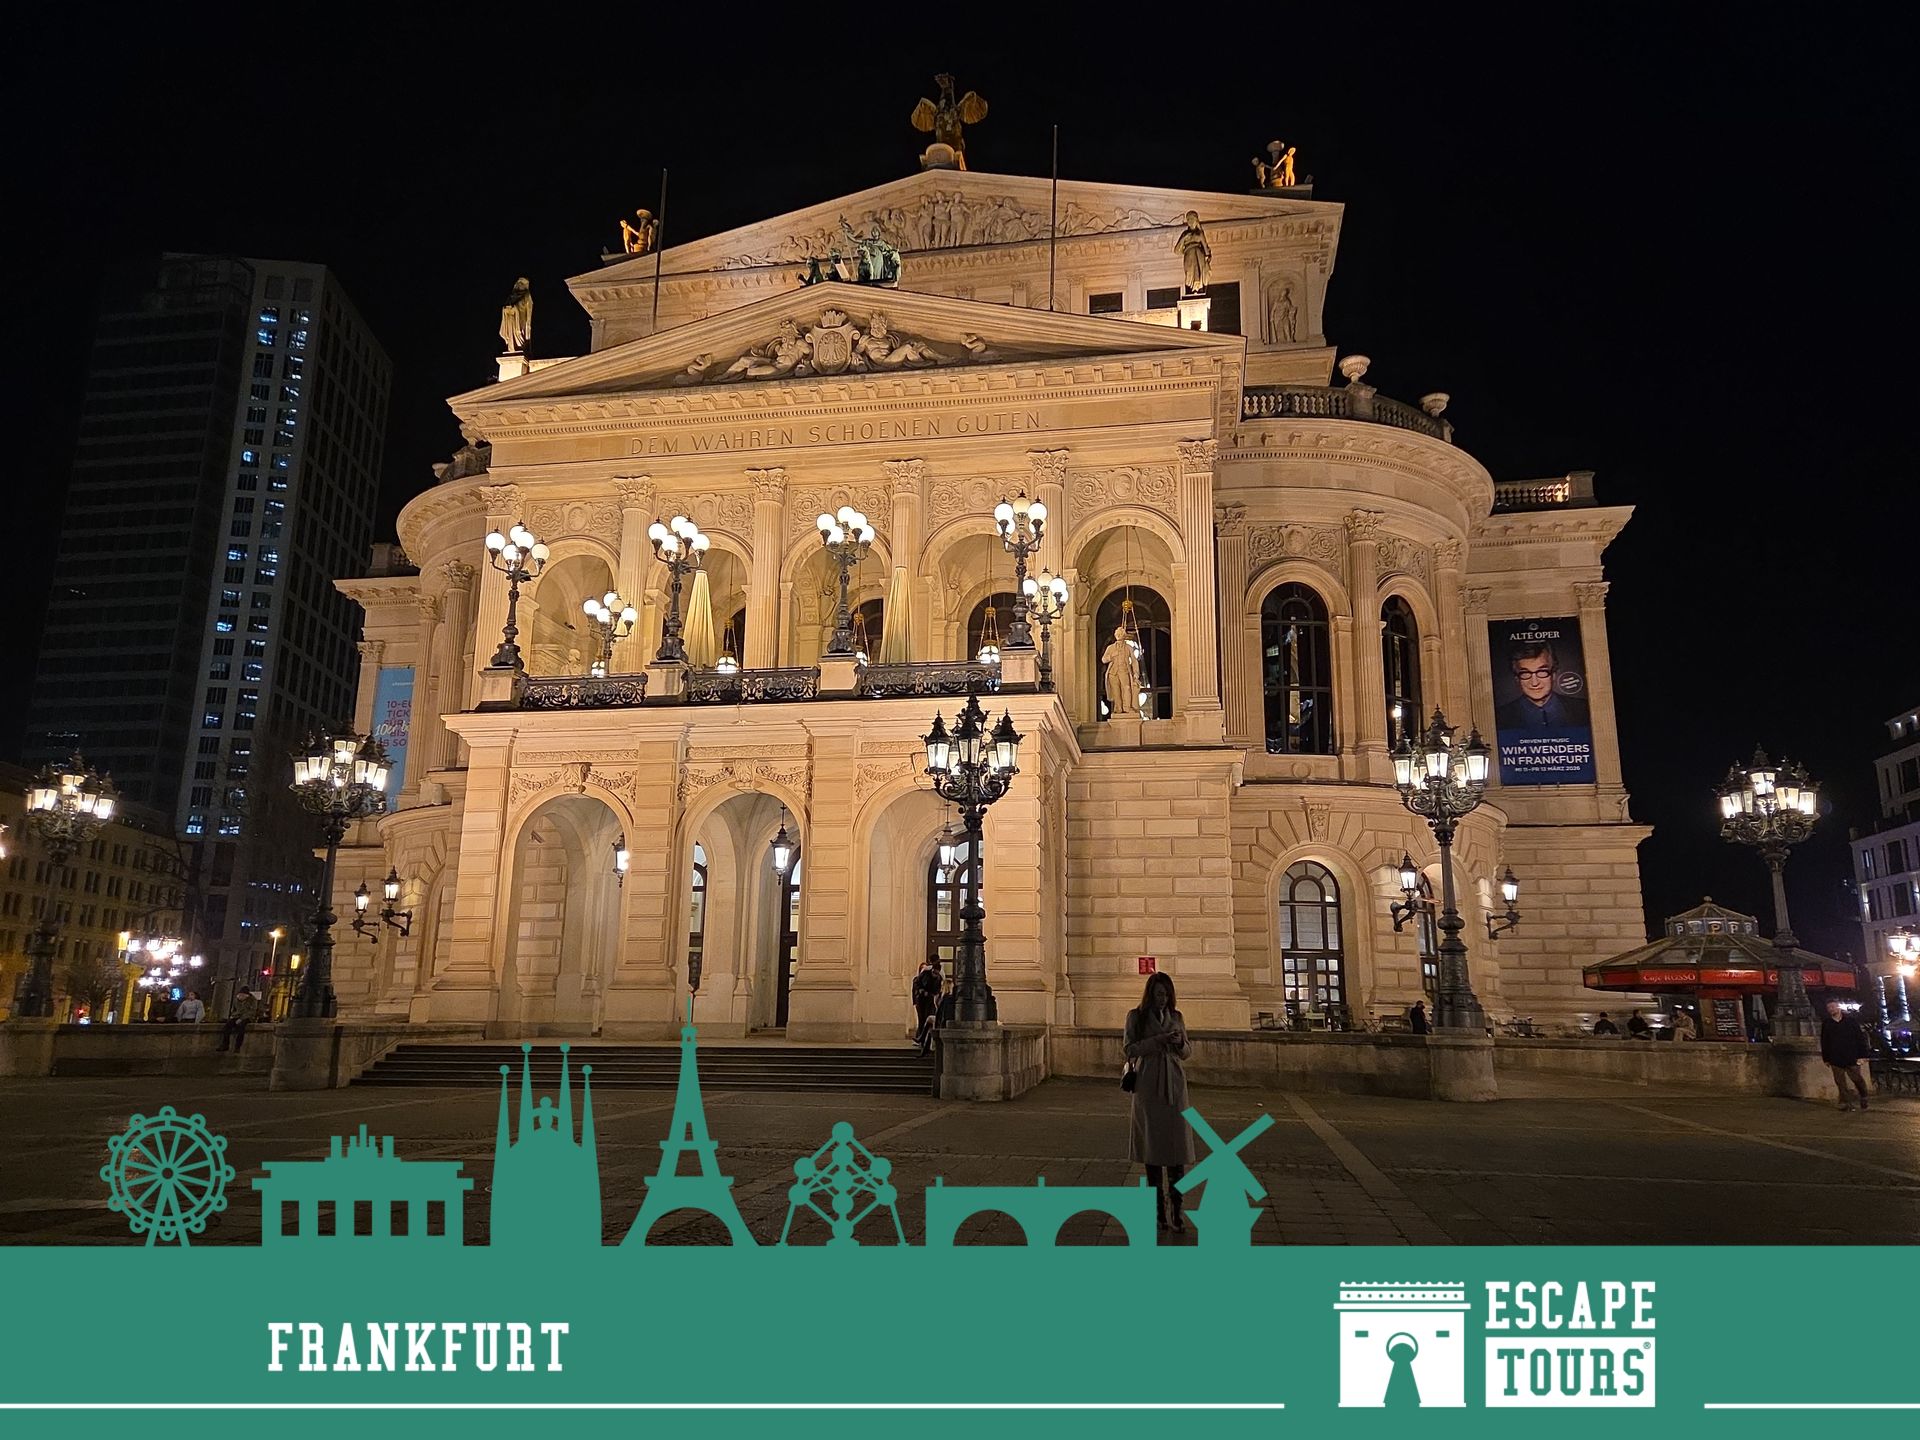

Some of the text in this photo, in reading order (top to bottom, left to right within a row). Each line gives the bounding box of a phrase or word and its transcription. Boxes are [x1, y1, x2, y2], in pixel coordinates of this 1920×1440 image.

[630, 435, 679, 455] DEM
[692, 427, 794, 452] WAHREN
[808, 415, 942, 443] SCHOENEN
[1509, 631, 1560, 640] ALTE OPER
[1502, 744, 1590, 755] WIM WENDERS
[1503, 755, 1590, 765] IN FRANKFURT
